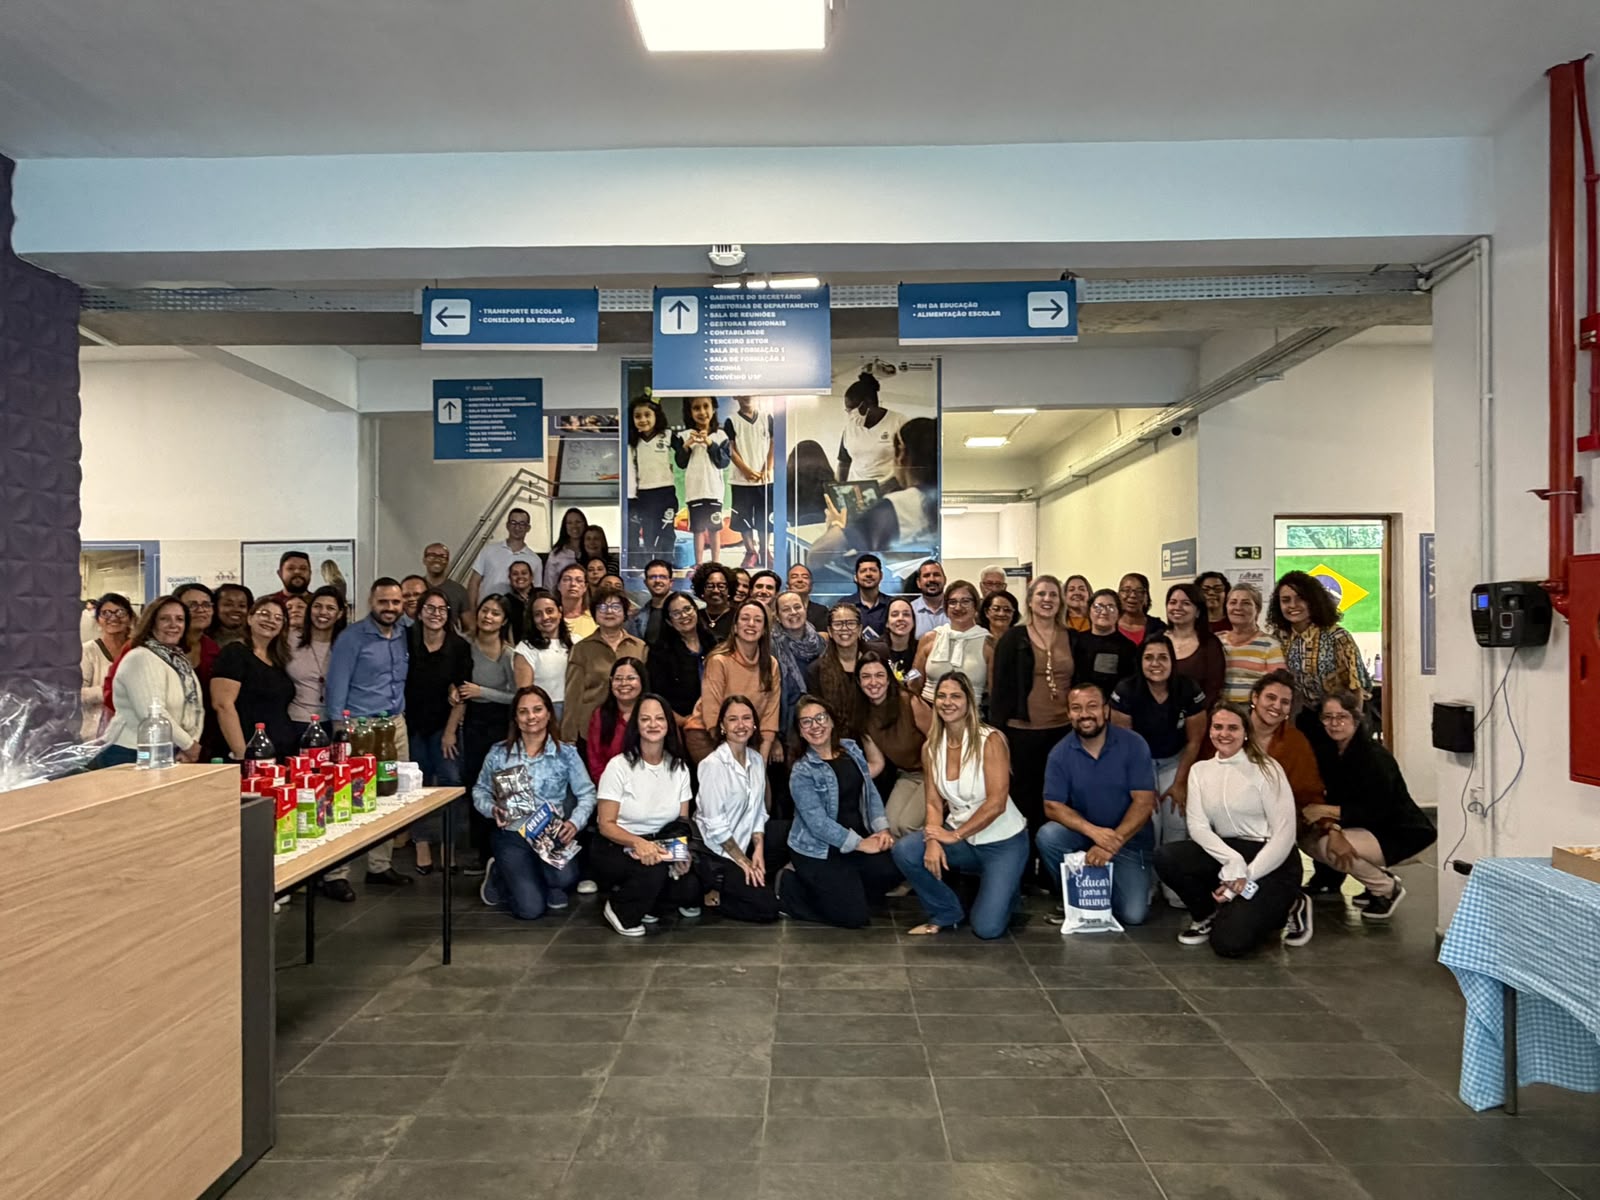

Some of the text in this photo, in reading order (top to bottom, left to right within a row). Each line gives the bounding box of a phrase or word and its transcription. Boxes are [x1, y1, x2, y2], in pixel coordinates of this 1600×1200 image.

[939, 301, 978, 310] EDUCAÇÃO
[917, 310, 967, 318] ALIMENTAÇÃO
[537, 315, 575, 324] EDUCAÇÃO
